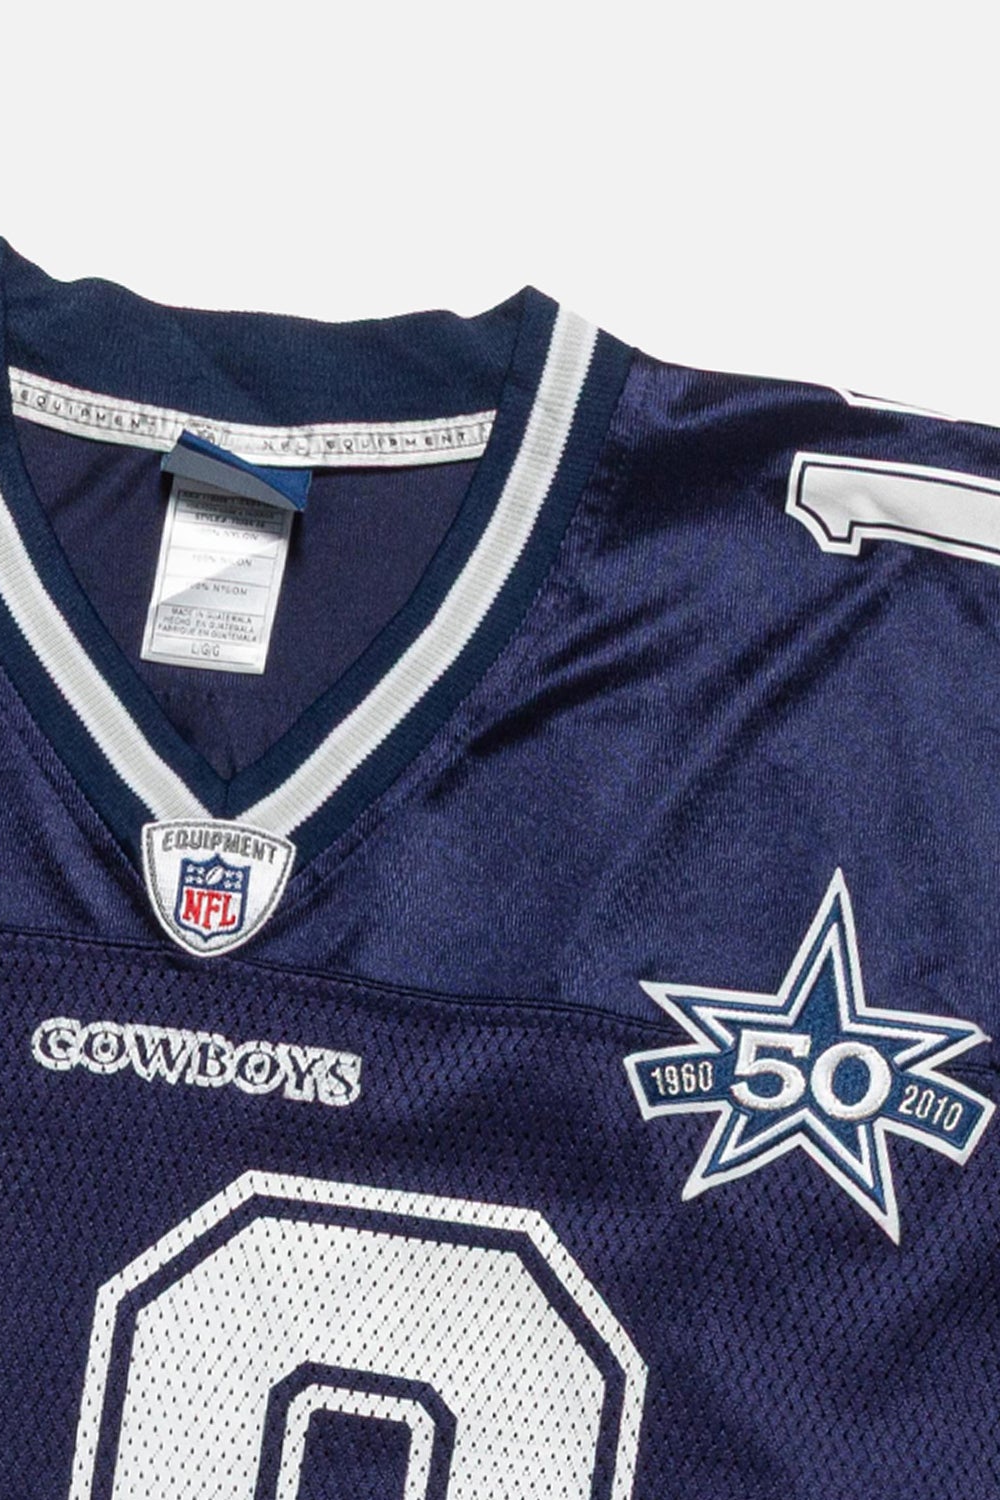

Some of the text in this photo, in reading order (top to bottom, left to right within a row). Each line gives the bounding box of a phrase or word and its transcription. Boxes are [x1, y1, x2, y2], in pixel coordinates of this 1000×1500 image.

[326, 431, 466, 451] EQUIPMENT
[161, 829, 280, 865] EQUIPMENT
[181, 887, 237, 931] NFL
[31, 1015, 363, 1108] COWBOYS
[650, 1029, 965, 1133] 1960 50 2010
